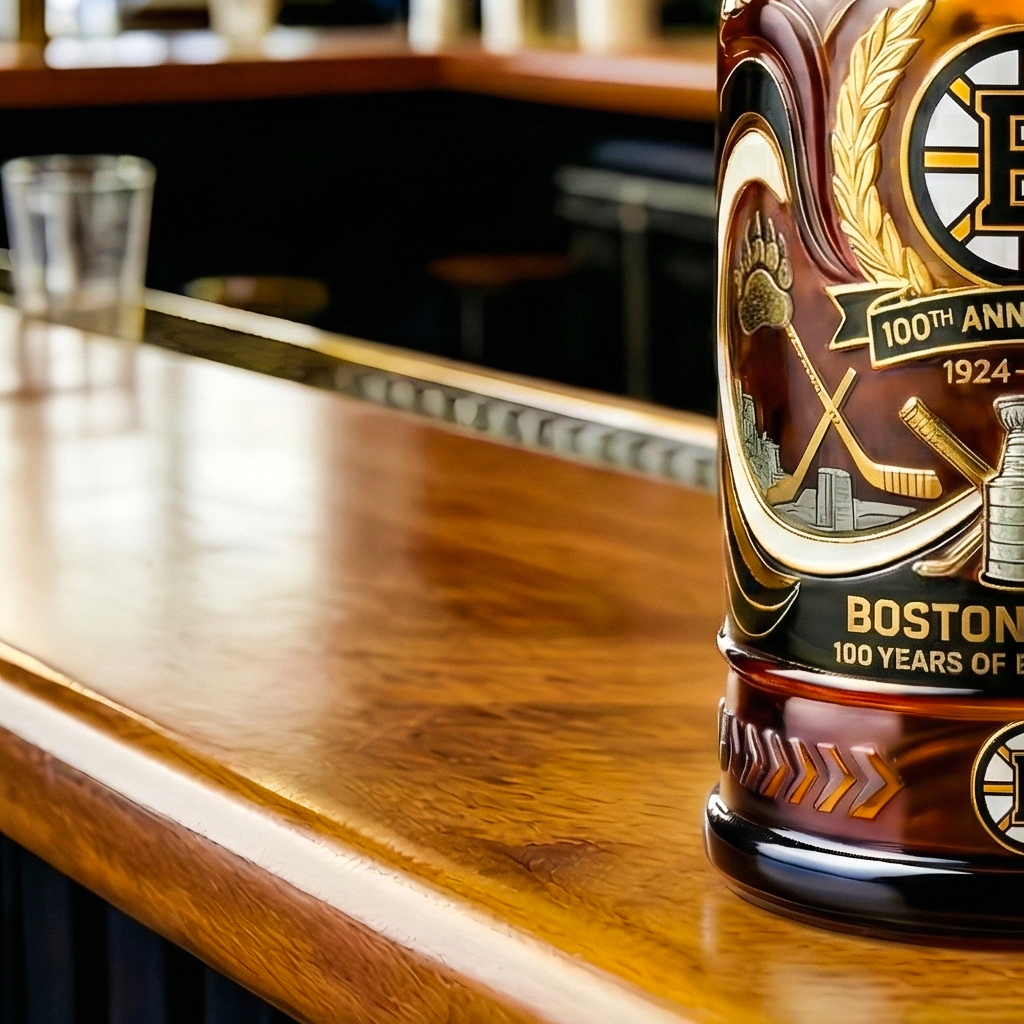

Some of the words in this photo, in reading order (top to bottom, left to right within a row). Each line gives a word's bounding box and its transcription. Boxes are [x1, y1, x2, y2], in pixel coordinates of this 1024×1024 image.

[881, 307, 954, 349] 100TH
[833, 641, 873, 666] 100
[877, 646, 963, 674] YEARS
[970, 651, 1006, 676] OF
